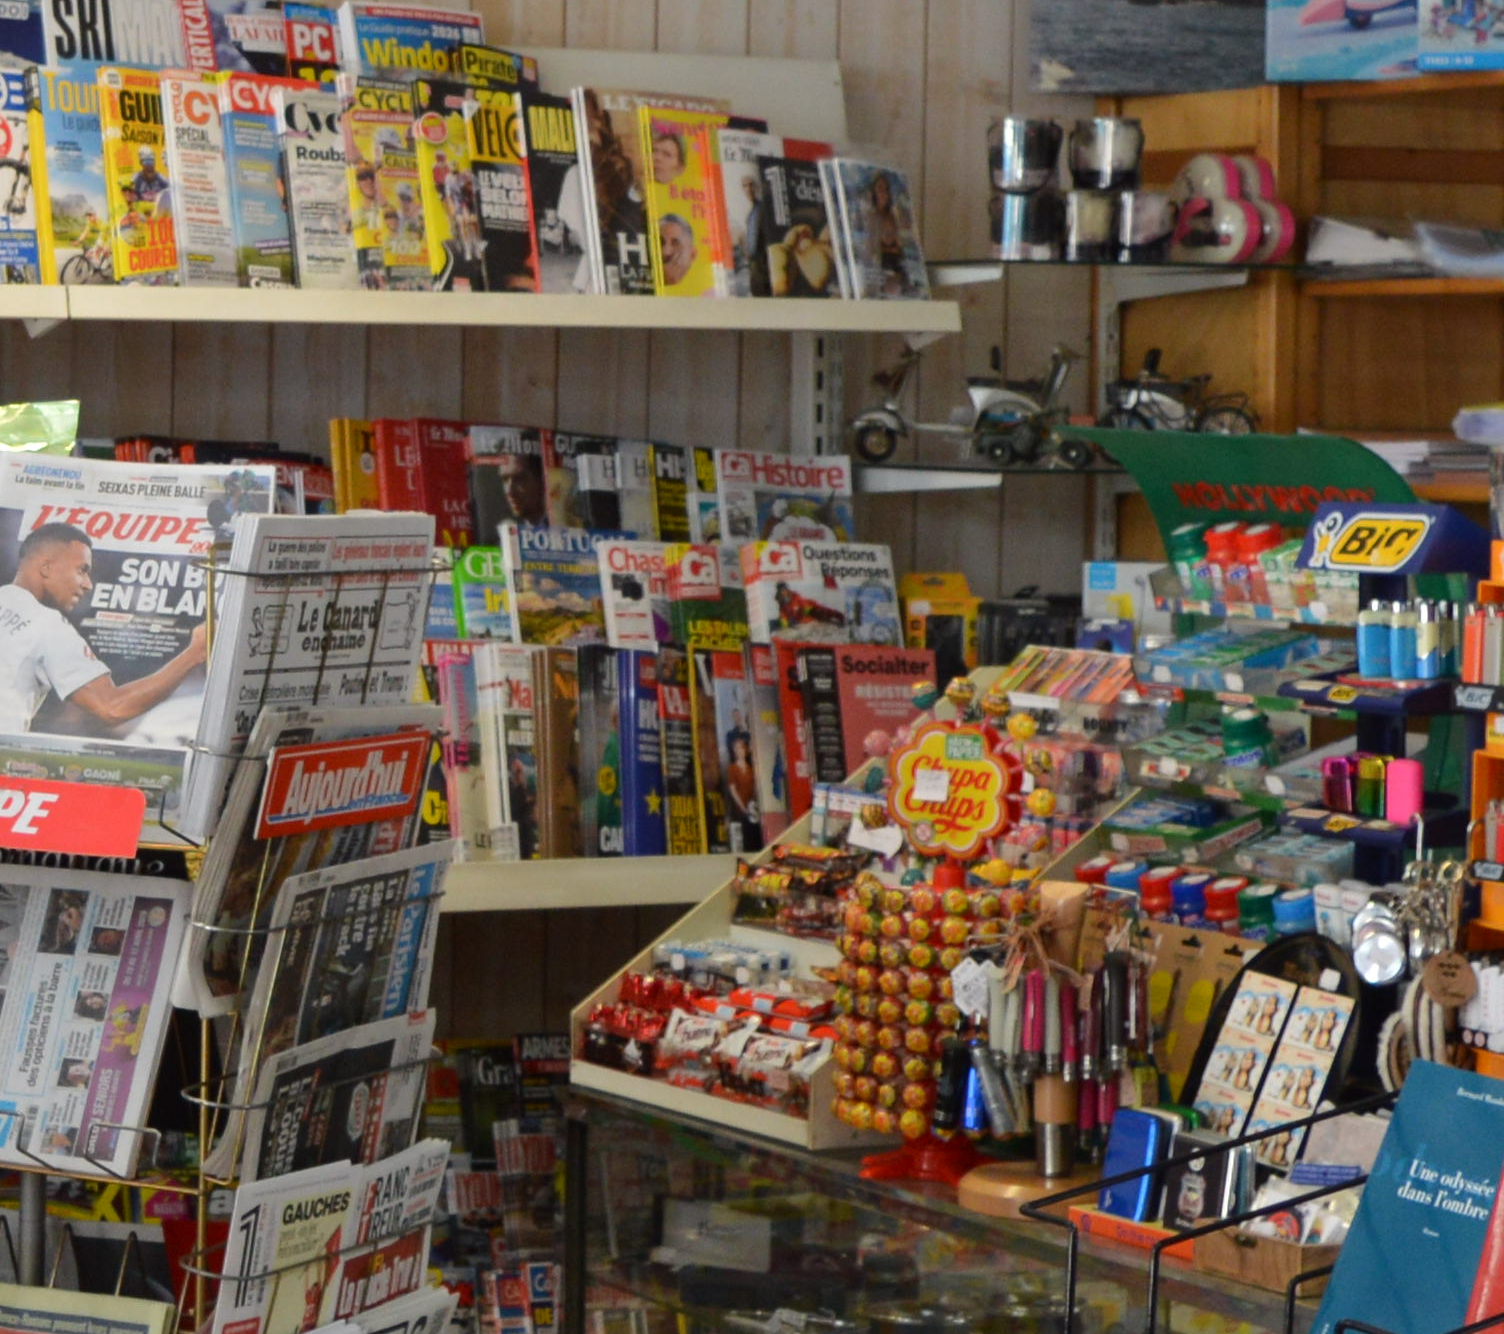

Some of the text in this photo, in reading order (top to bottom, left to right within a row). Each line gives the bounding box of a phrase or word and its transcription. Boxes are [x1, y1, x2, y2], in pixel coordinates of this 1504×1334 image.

[290, 22, 331, 62] PC
[98, 481, 206, 500] SEIXAS PLEINE BALLE
[751, 462, 844, 491] Histoire
[1173, 481, 1370, 513] HOLLYWOOD
[30, 504, 208, 546] L'ÉQUIPE
[803, 545, 877, 563] Questions
[120, 559, 179, 586] SON
[92, 583, 132, 610] EN
[297, 598, 383, 633] Le Canard
[840, 654, 932, 677] Socialter
[1408, 1159, 1494, 1197] Une odyssée
[282, 1190, 351, 1225] GAUCHES
[1397, 1183, 1489, 1221] dans l'ombre
